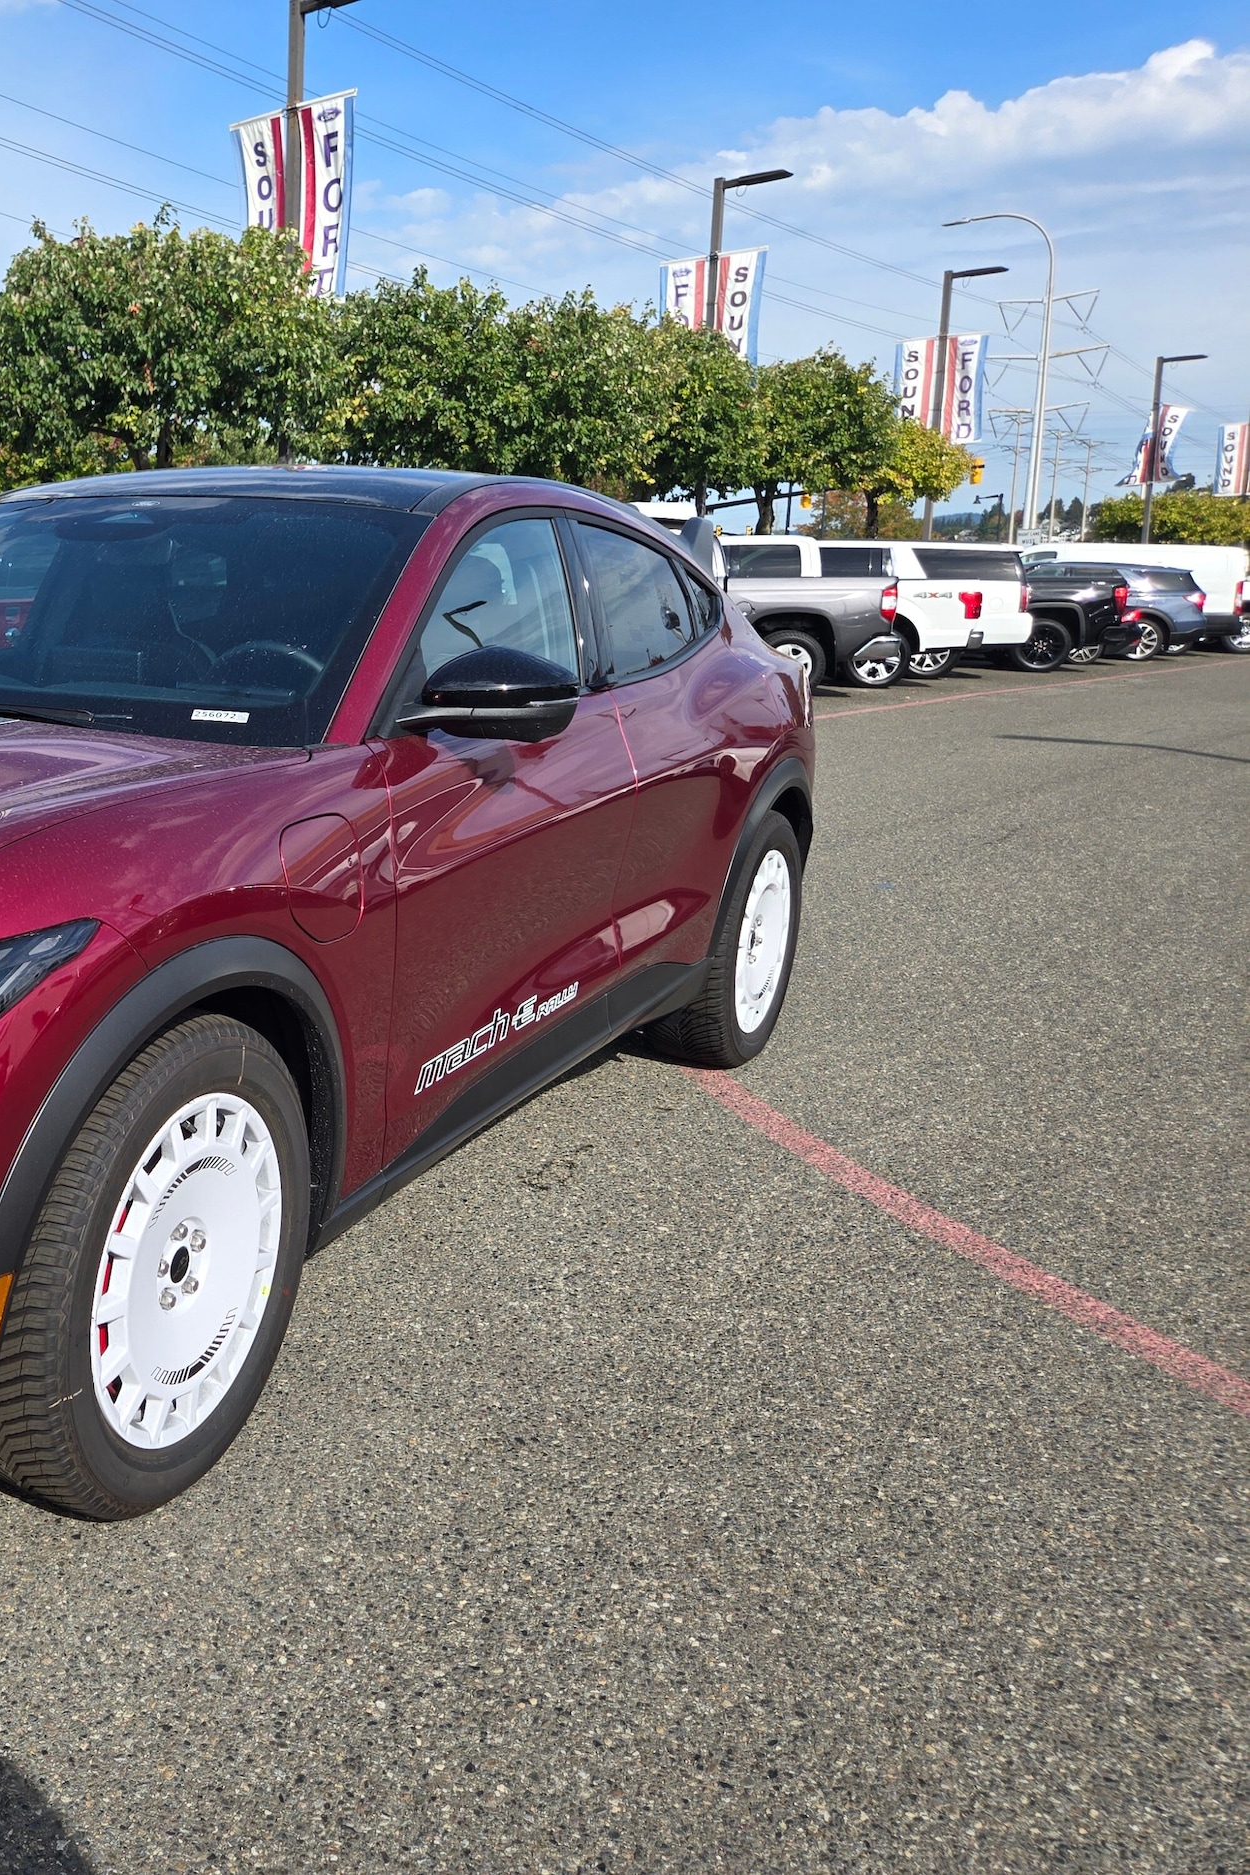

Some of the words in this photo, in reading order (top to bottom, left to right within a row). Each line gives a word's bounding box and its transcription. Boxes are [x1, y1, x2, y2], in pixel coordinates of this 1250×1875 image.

[253, 141, 273, 232] SOU
[729, 266, 749, 353] SOUN
[901, 350, 919, 417] SOUN
[956, 351, 974, 439] FORD
[1160, 414, 1179, 476] SOUND
[1222, 432, 1235, 488] SOUND
